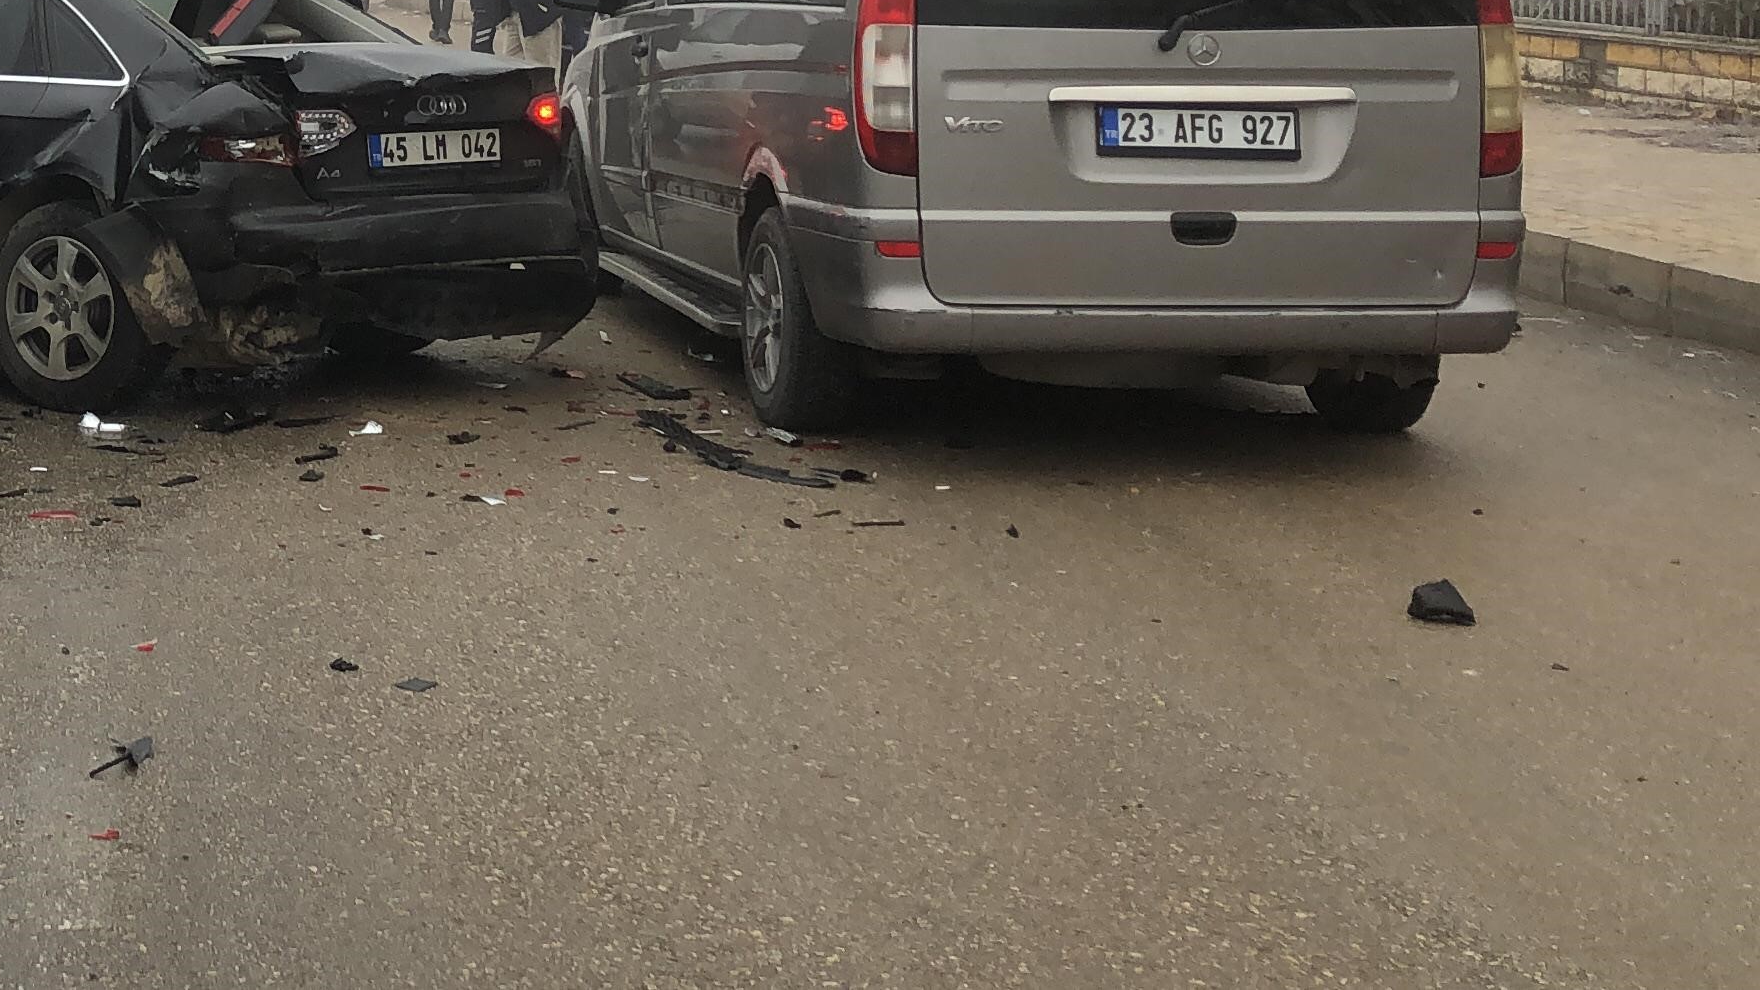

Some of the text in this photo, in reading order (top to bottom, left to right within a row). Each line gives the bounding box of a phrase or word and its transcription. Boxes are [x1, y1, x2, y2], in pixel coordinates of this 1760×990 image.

[1121, 112, 1154, 143] 23
[1174, 113, 1223, 144] AFG
[1242, 115, 1291, 146] 927
[383, 136, 408, 163] 45
[422, 134, 447, 161] LM
[461, 131, 497, 159] 042
[316, 166, 341, 180] A4
